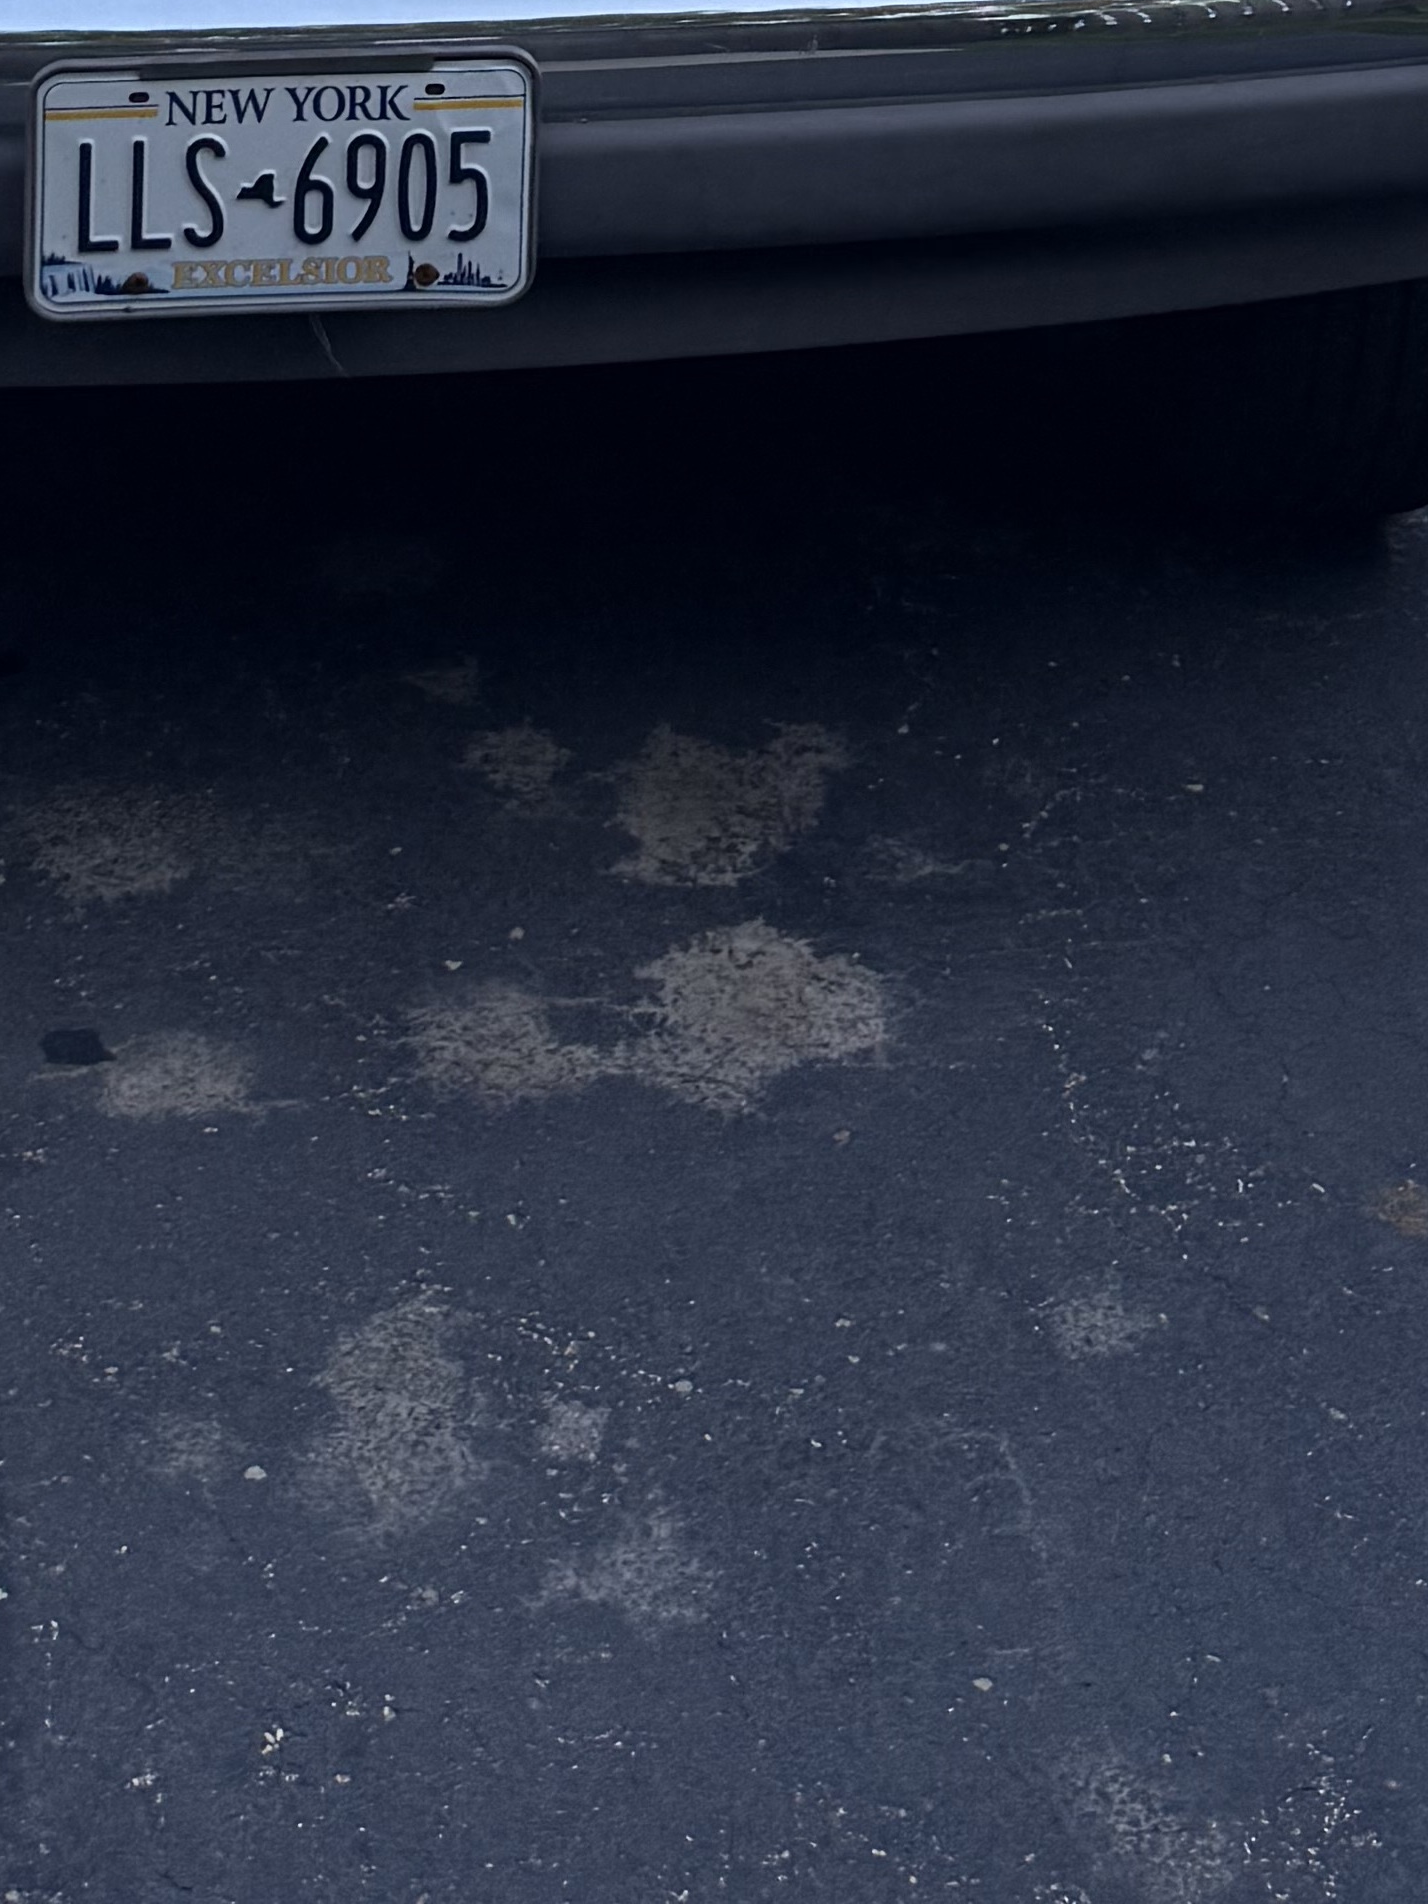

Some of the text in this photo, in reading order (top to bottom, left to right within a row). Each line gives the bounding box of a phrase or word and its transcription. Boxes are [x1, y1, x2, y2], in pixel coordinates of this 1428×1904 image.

[165, 83, 412, 126] NEW YORK
[78, 129, 494, 254] LLS 6905
[172, 254, 393, 290] EXCELSIOR
